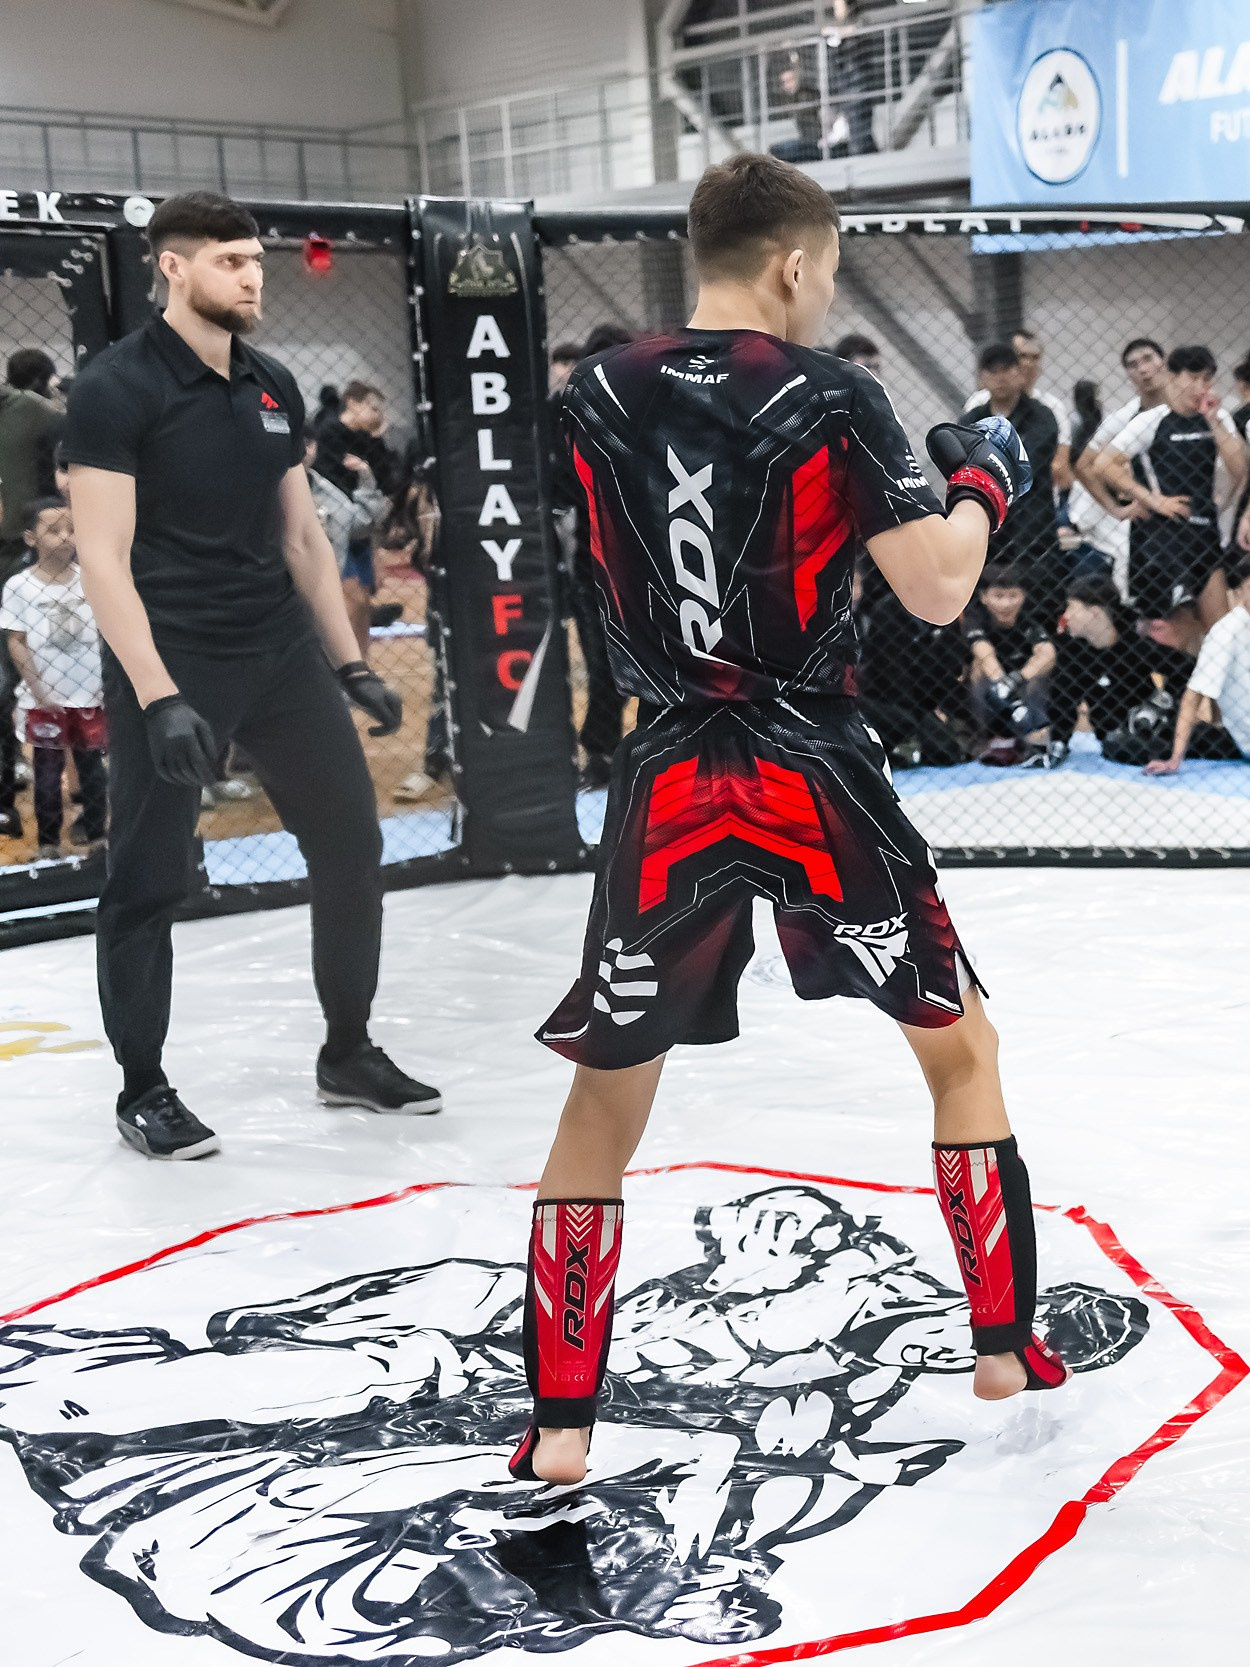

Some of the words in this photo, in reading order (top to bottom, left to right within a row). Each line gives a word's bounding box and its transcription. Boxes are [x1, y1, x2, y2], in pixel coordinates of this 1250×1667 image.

[660, 365, 729, 384] IMMAF
[466, 315, 523, 581] ABLAY
[667, 444, 723, 657] RDX
[833, 912, 908, 936] RDX
[944, 1178, 983, 1287] RDX
[563, 1234, 590, 1351] RDX
